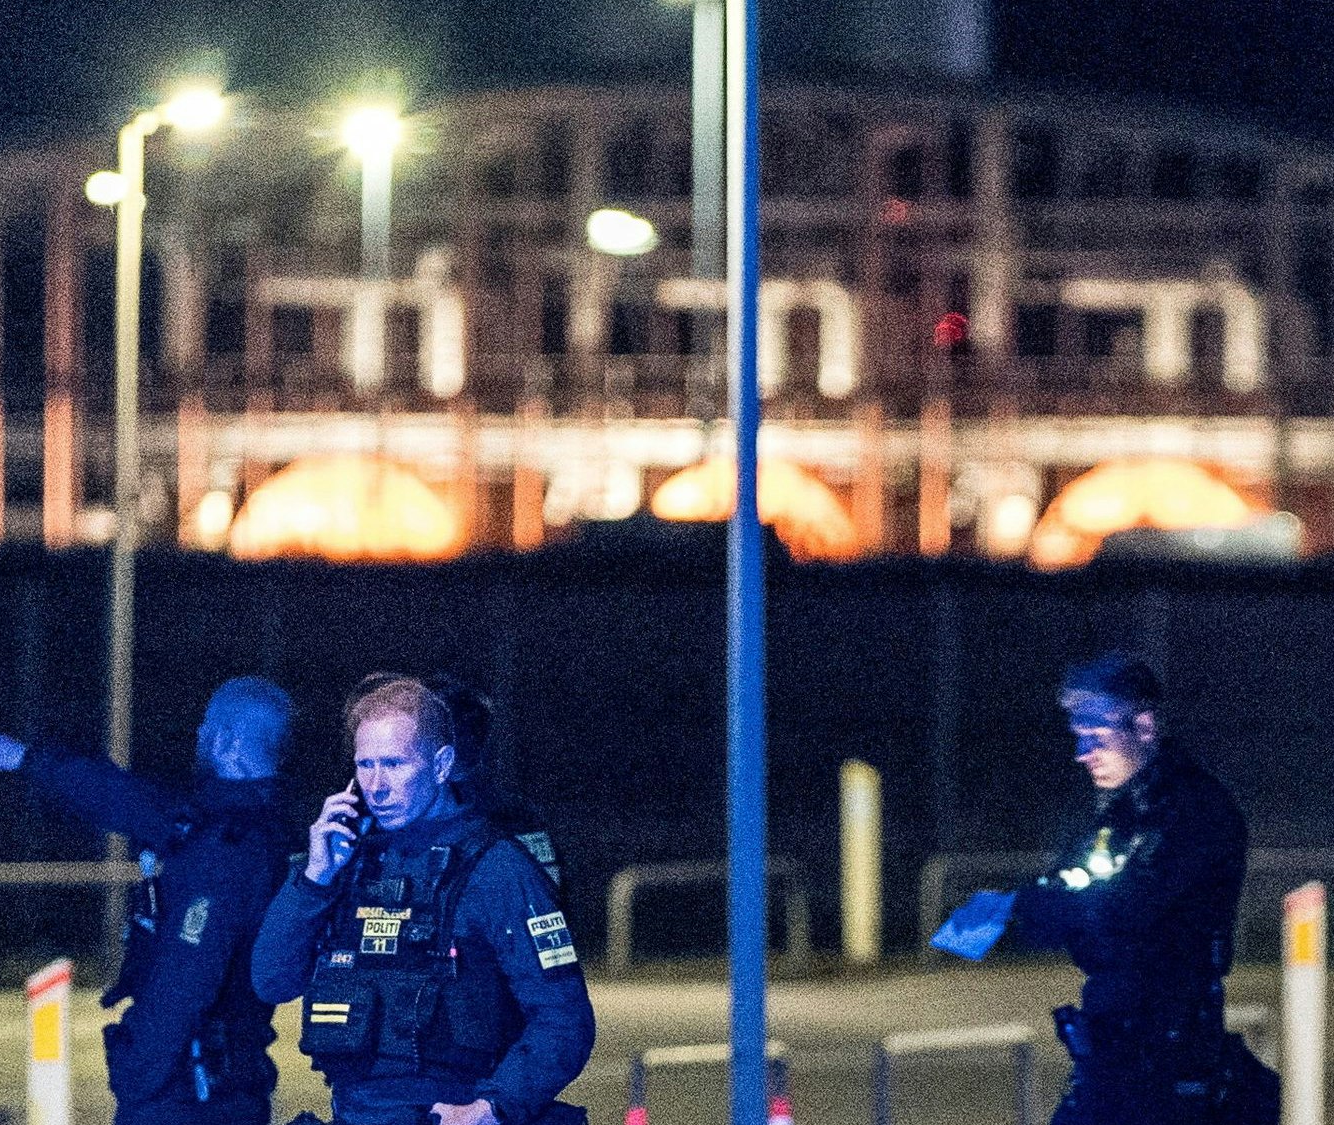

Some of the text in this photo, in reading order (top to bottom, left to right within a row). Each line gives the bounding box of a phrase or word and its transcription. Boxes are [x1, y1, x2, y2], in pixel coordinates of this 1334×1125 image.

[366, 922, 398, 934] POLITI
[531, 916, 564, 932] POLITI
[372, 938, 386, 952] 11
[547, 931, 562, 947] 11
